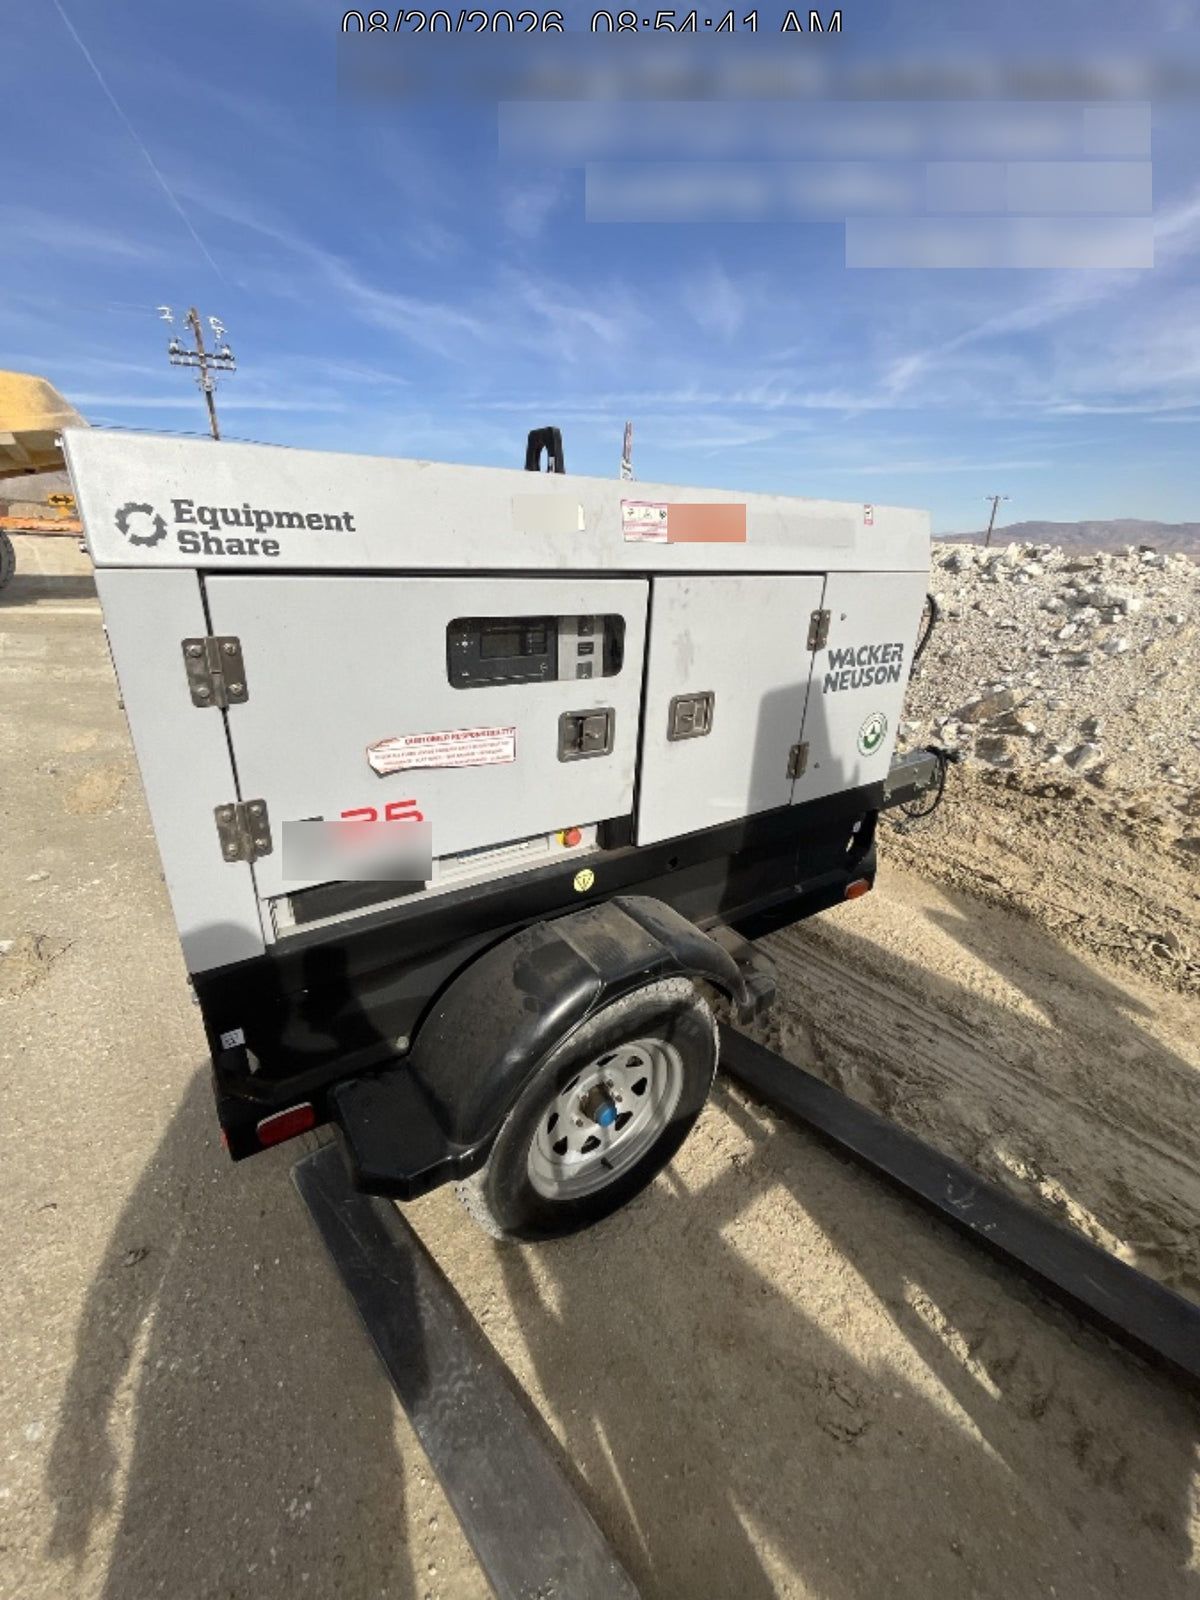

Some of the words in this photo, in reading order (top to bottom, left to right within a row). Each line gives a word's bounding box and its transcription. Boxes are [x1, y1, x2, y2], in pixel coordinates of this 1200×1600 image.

[171, 498, 356, 533] Equipment
[177, 529, 280, 557] Share
[828, 643, 904, 671] WACKER
[823, 664, 902, 694] NEUSON
